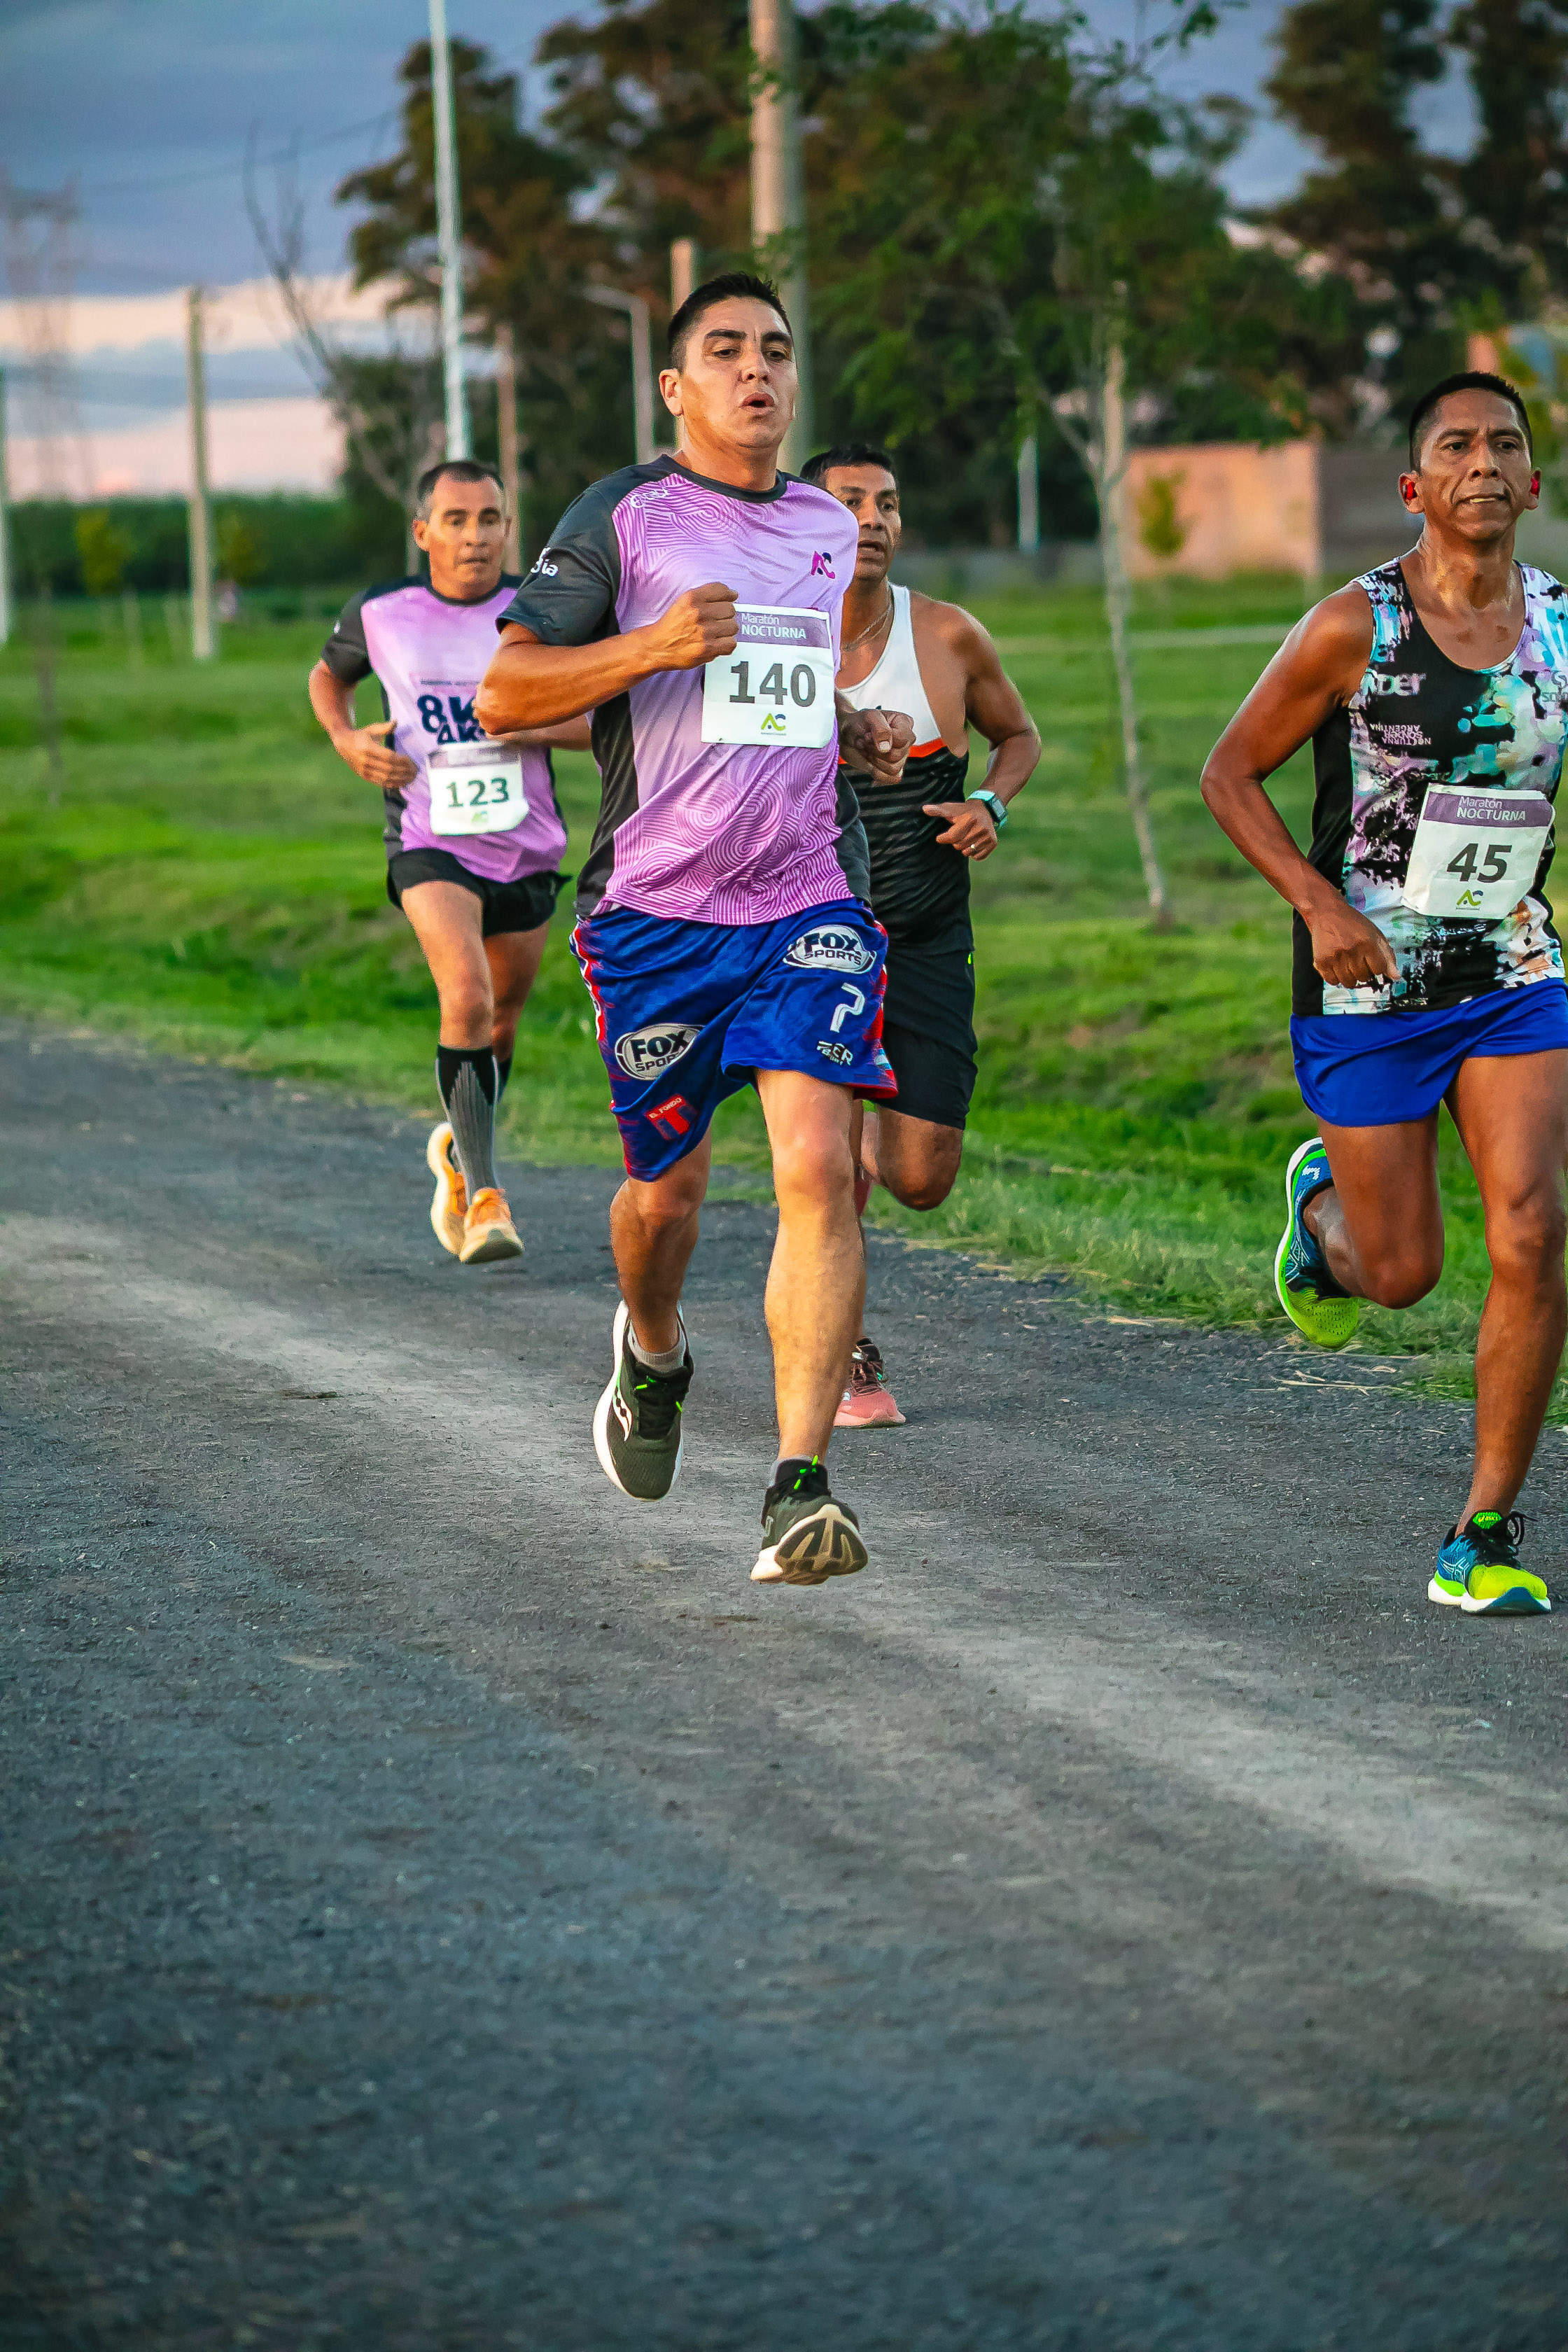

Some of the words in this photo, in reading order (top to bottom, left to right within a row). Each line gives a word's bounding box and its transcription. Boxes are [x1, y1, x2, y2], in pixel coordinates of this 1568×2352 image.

[741, 612, 780, 625] Maratón
[741, 624, 806, 639] NOCTURNA
[729, 661, 816, 707] 140
[1370, 723, 1420, 732] ARGENTINA
[1382, 737, 1432, 746] NOCTURNA
[446, 776, 510, 808] 123
[1458, 796, 1503, 809] Maratón
[1457, 806, 1526, 821] NOCTURNA
[1446, 843, 1512, 883] 45
[804, 932, 859, 953] FOX
[805, 949, 862, 966] SPORTS
[630, 1029, 690, 1063] FOX
